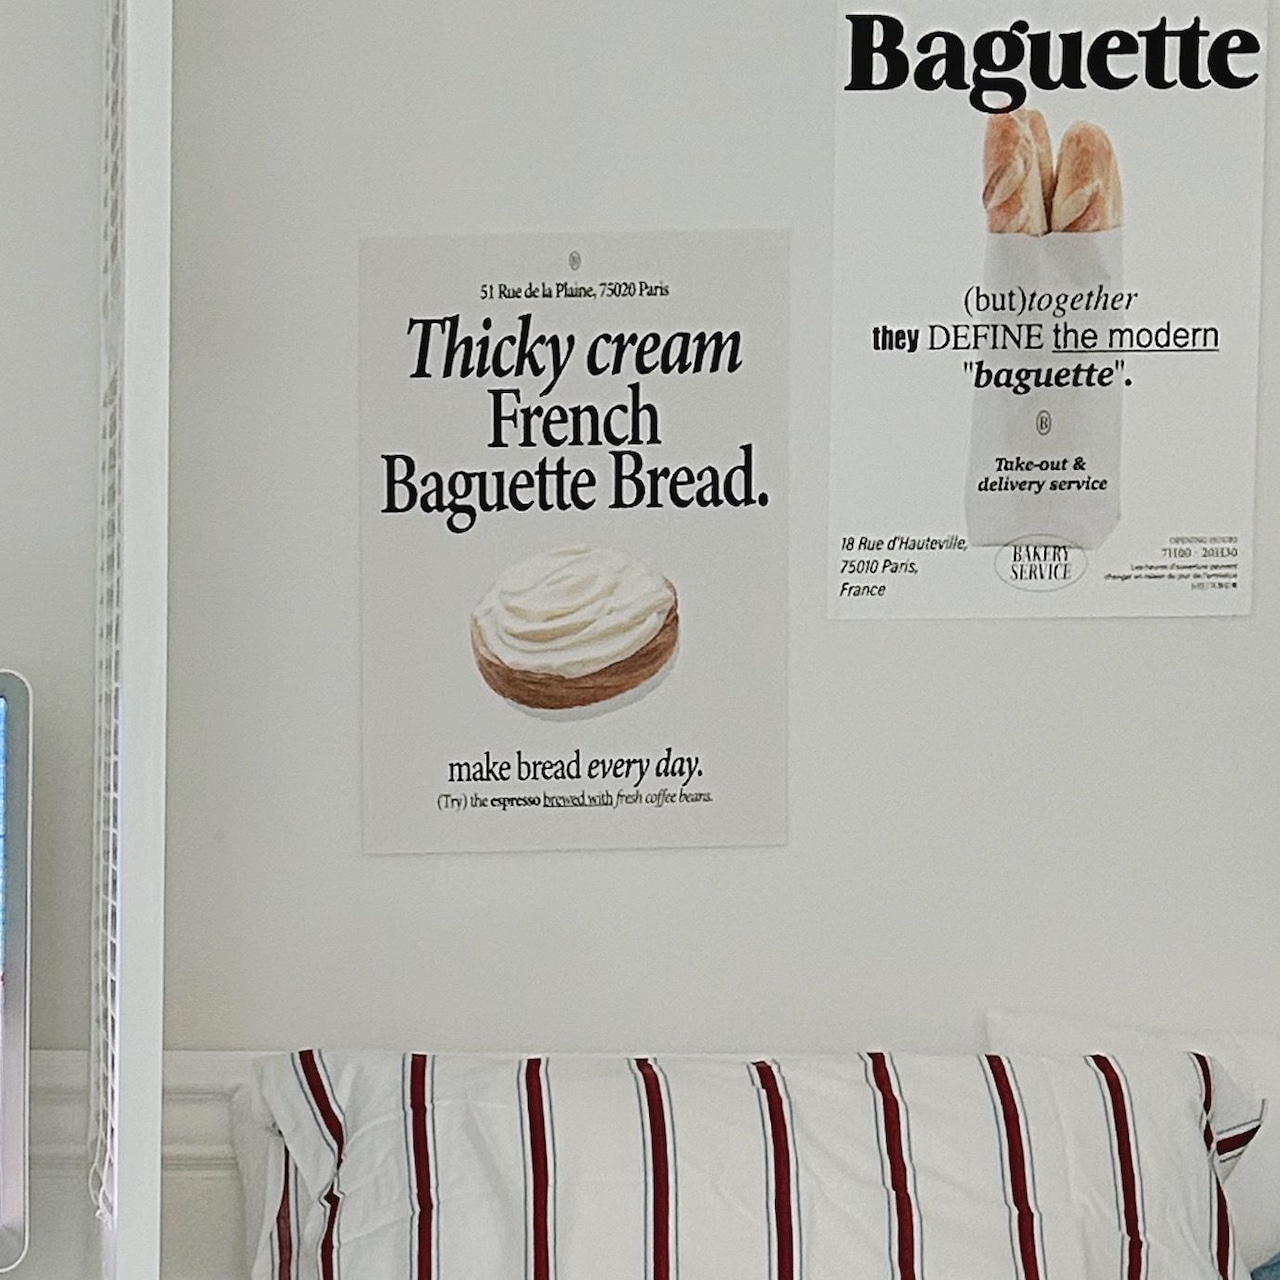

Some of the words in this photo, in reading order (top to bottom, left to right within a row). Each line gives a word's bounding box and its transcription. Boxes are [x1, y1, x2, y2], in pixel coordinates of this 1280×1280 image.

[843, 14, 1261, 117] Baguette
[480, 284, 495, 301] 51
[497, 283, 522, 300] Rue
[524, 283, 540, 299] de
[541, 283, 553, 299] la
[555, 282, 597, 299] Plaine,
[599, 281, 637, 298] 75020
[639, 280, 670, 297] Paris
[964, 284, 1139, 319] (but)together
[872, 324, 920, 354] they
[927, 323, 1044, 350] DEFINE
[1052, 321, 1099, 350] the
[1108, 320, 1219, 348] modern
[406, 312, 576, 398] Thicky
[586, 330, 743, 377] cream
[487, 381, 663, 448] French
[995, 456, 1069, 472] Take-out
[1072, 456, 1087, 471] &
[380, 454, 597, 535] Baguette
[608, 442, 769, 509] Bread.
[977, 475, 1047, 495] delivery
[1048, 475, 1108, 492] service
[841, 536, 855, 552] 18
[857, 536, 885, 551] Rue
[1011, 546, 1071, 564] BAKERY
[840, 559, 880, 575] 75010
[881, 558, 919, 575] Paris,
[1009, 563, 1072, 582] SERVICE
[839, 582, 887, 597] France
[447, 750, 512, 783] make
[516, 748, 582, 782] bread
[587, 757, 651, 788] every
[655, 747, 703, 788] day.
[437, 793, 468, 811] (Try)
[470, 792, 489, 808] the
[490, 795, 542, 811] espresso
